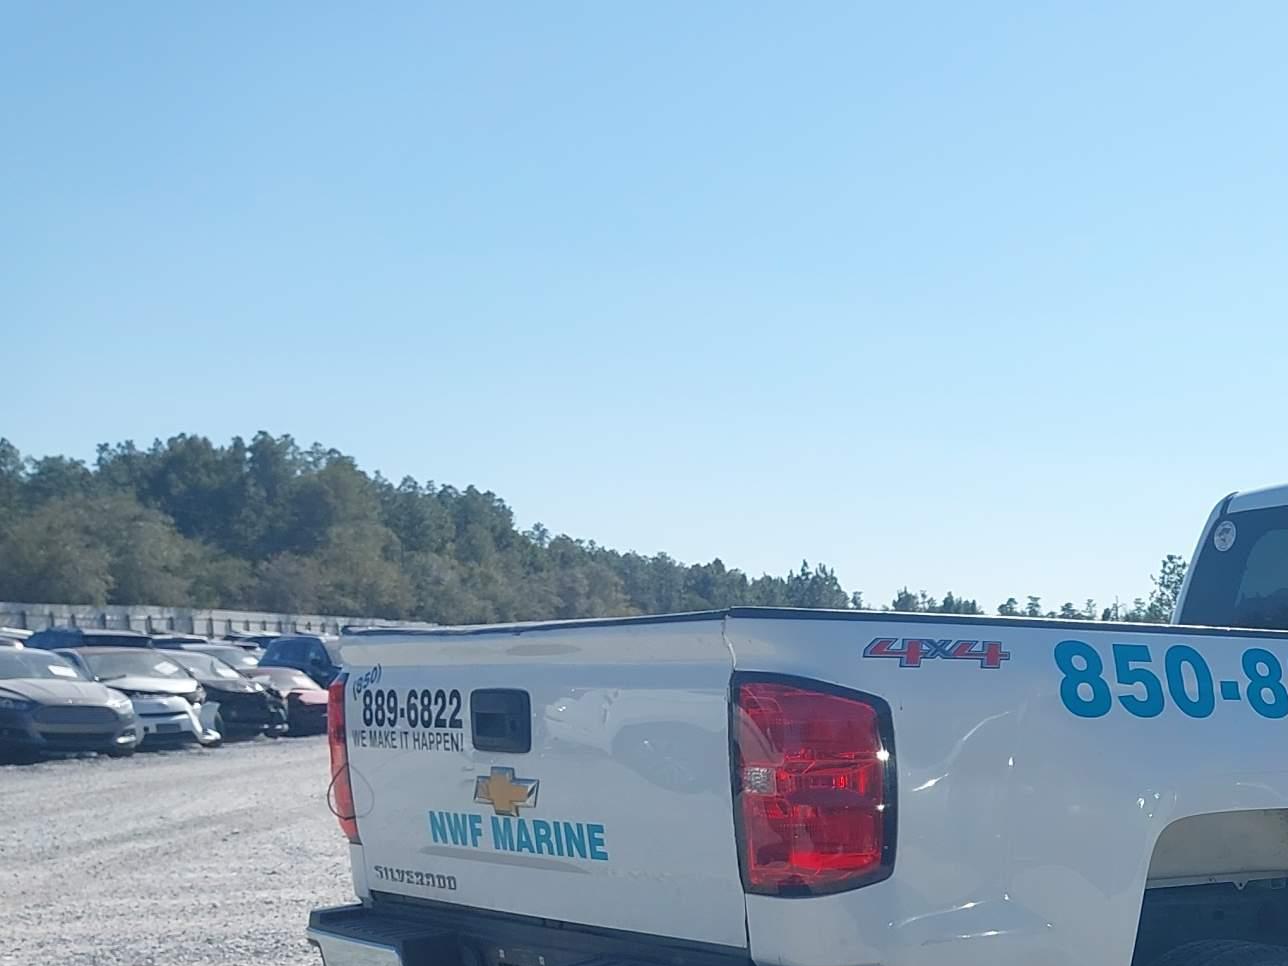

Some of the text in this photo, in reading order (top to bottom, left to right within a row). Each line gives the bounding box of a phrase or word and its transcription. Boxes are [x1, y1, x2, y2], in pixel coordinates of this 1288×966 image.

[353, 664, 382, 700] (850)
[362, 689, 463, 729] 889-6822
[352, 730, 464, 752] WE MAKE IT HAPPEN!
[428, 810, 609, 861] NWF MARINE
[374, 865, 457, 890] SILVERADO
